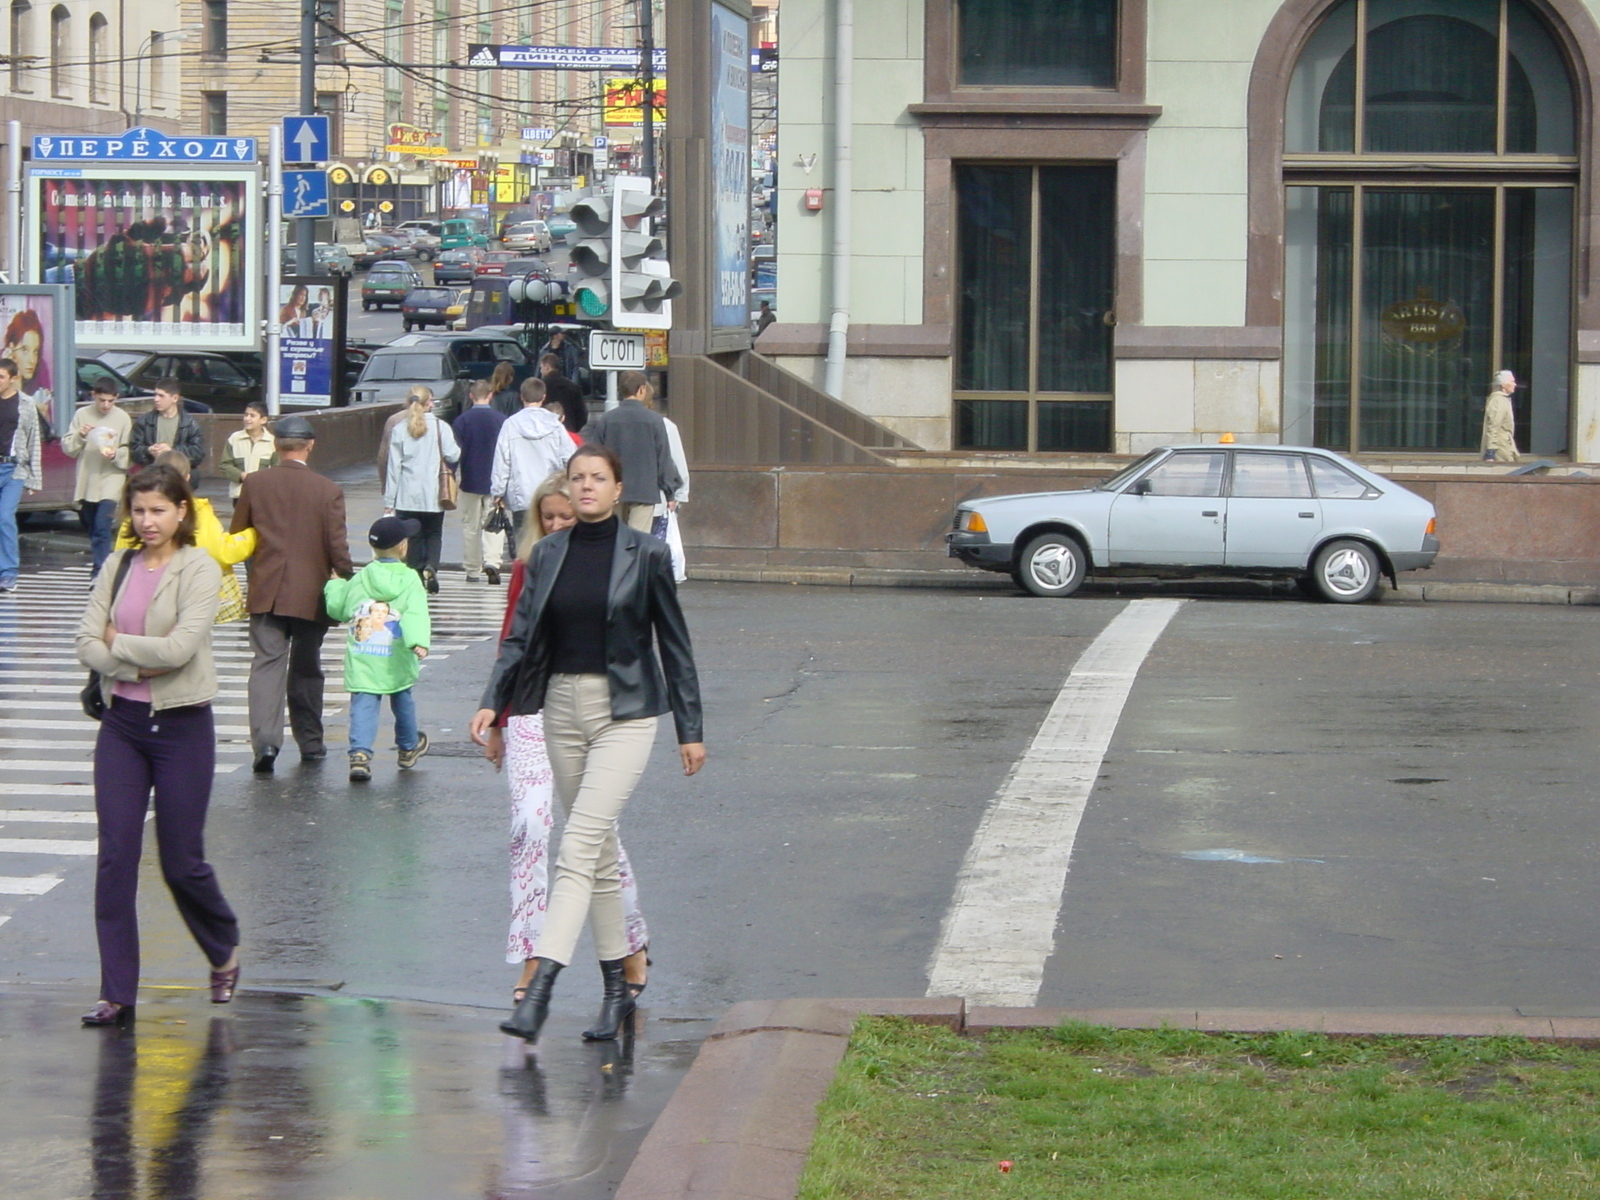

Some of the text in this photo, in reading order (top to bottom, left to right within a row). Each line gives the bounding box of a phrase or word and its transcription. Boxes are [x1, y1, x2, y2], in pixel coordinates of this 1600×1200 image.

[469, 58, 498, 66] adidas
[513, 53, 602, 62] ДИНАМО
[523, 129, 553, 139] ЦВЕТЫ
[59, 139, 228, 158] ПЕРЕХОД
[601, 339, 635, 360] СТОП
